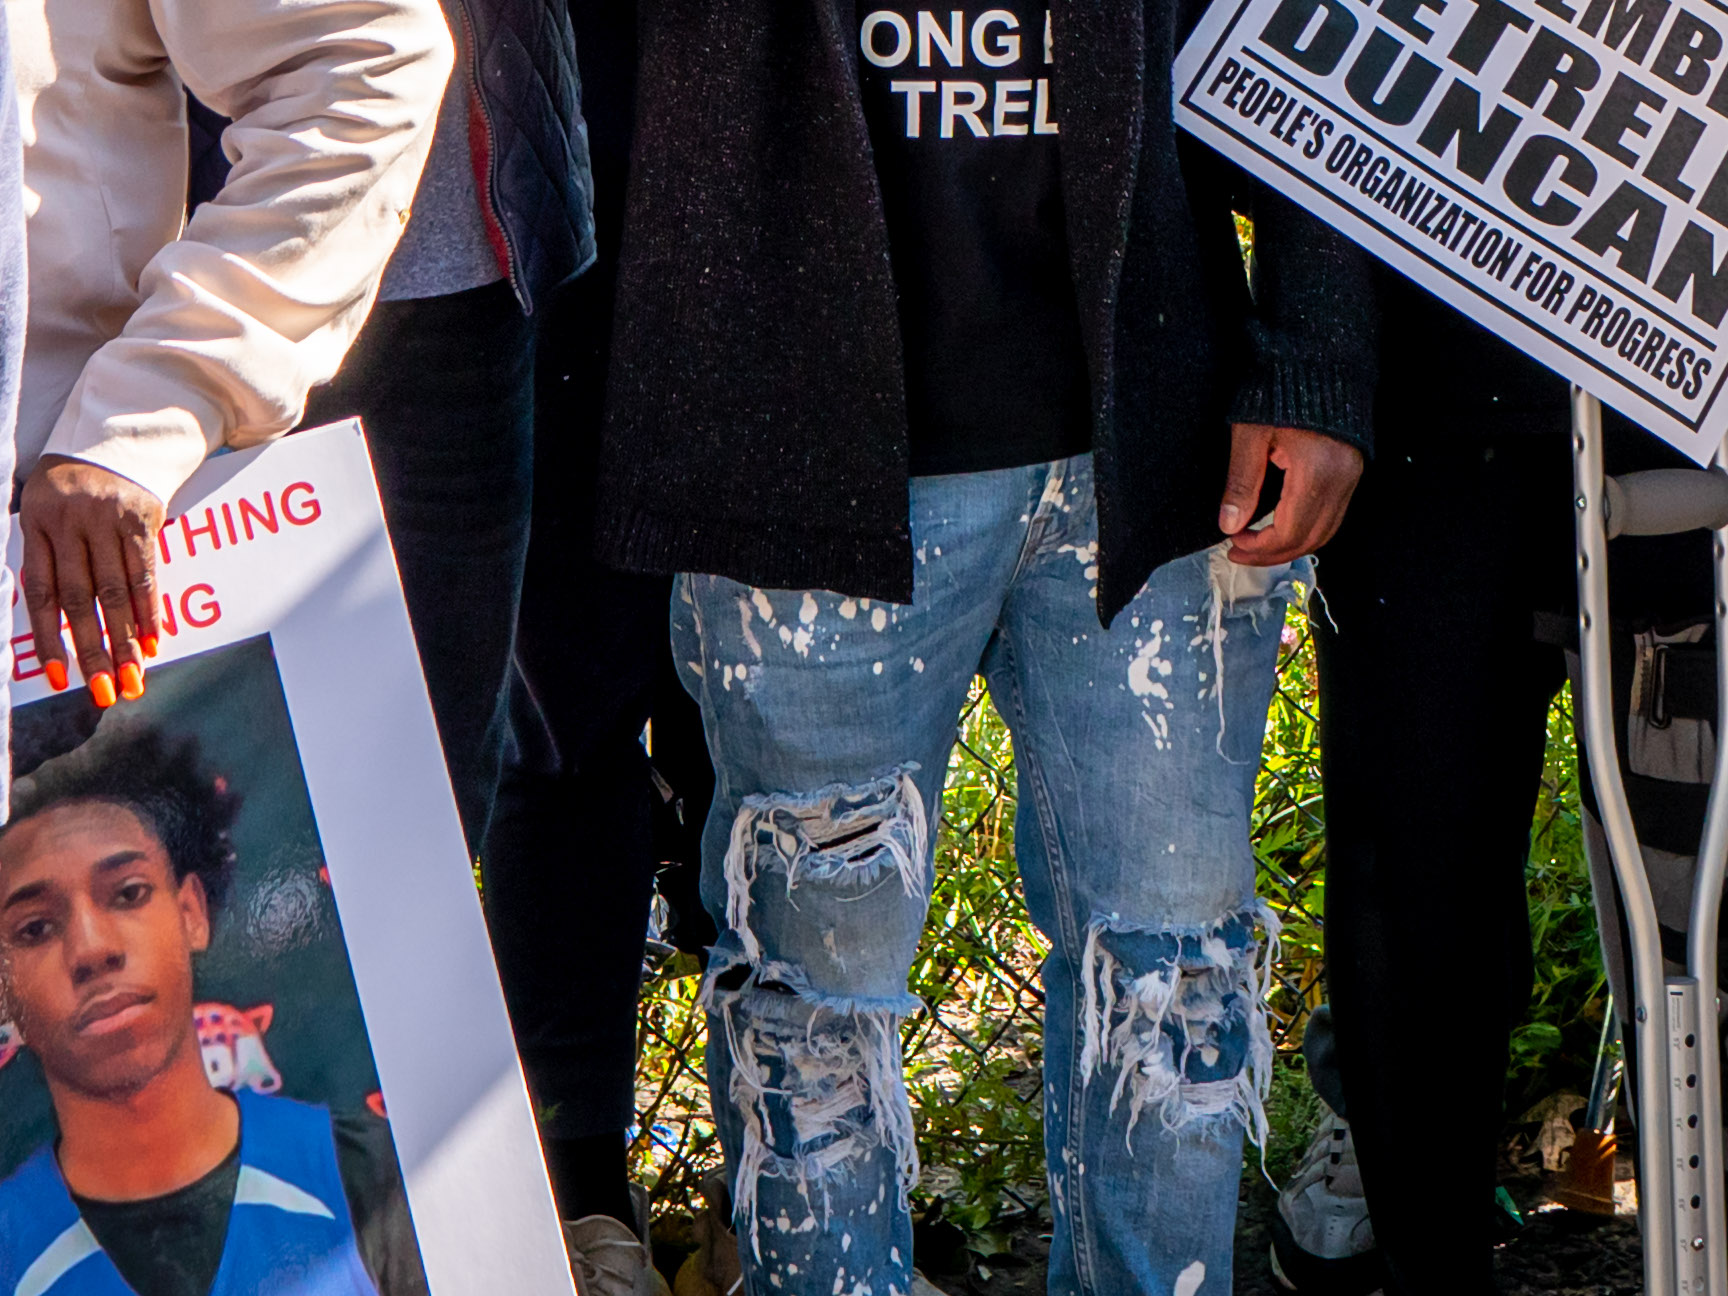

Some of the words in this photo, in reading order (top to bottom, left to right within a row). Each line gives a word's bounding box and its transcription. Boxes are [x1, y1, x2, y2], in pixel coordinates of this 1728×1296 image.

[860, 9, 1021, 68] ONG
[890, 79, 1059, 139] TREL
[1206, 59, 1334, 160] PEOPLE'S
[1330, 134, 1522, 282] ORGANIZATION
[1516, 252, 1574, 316] FOR
[1572, 284, 1712, 402] PROGRESS
[158, 482, 322, 565] THING
